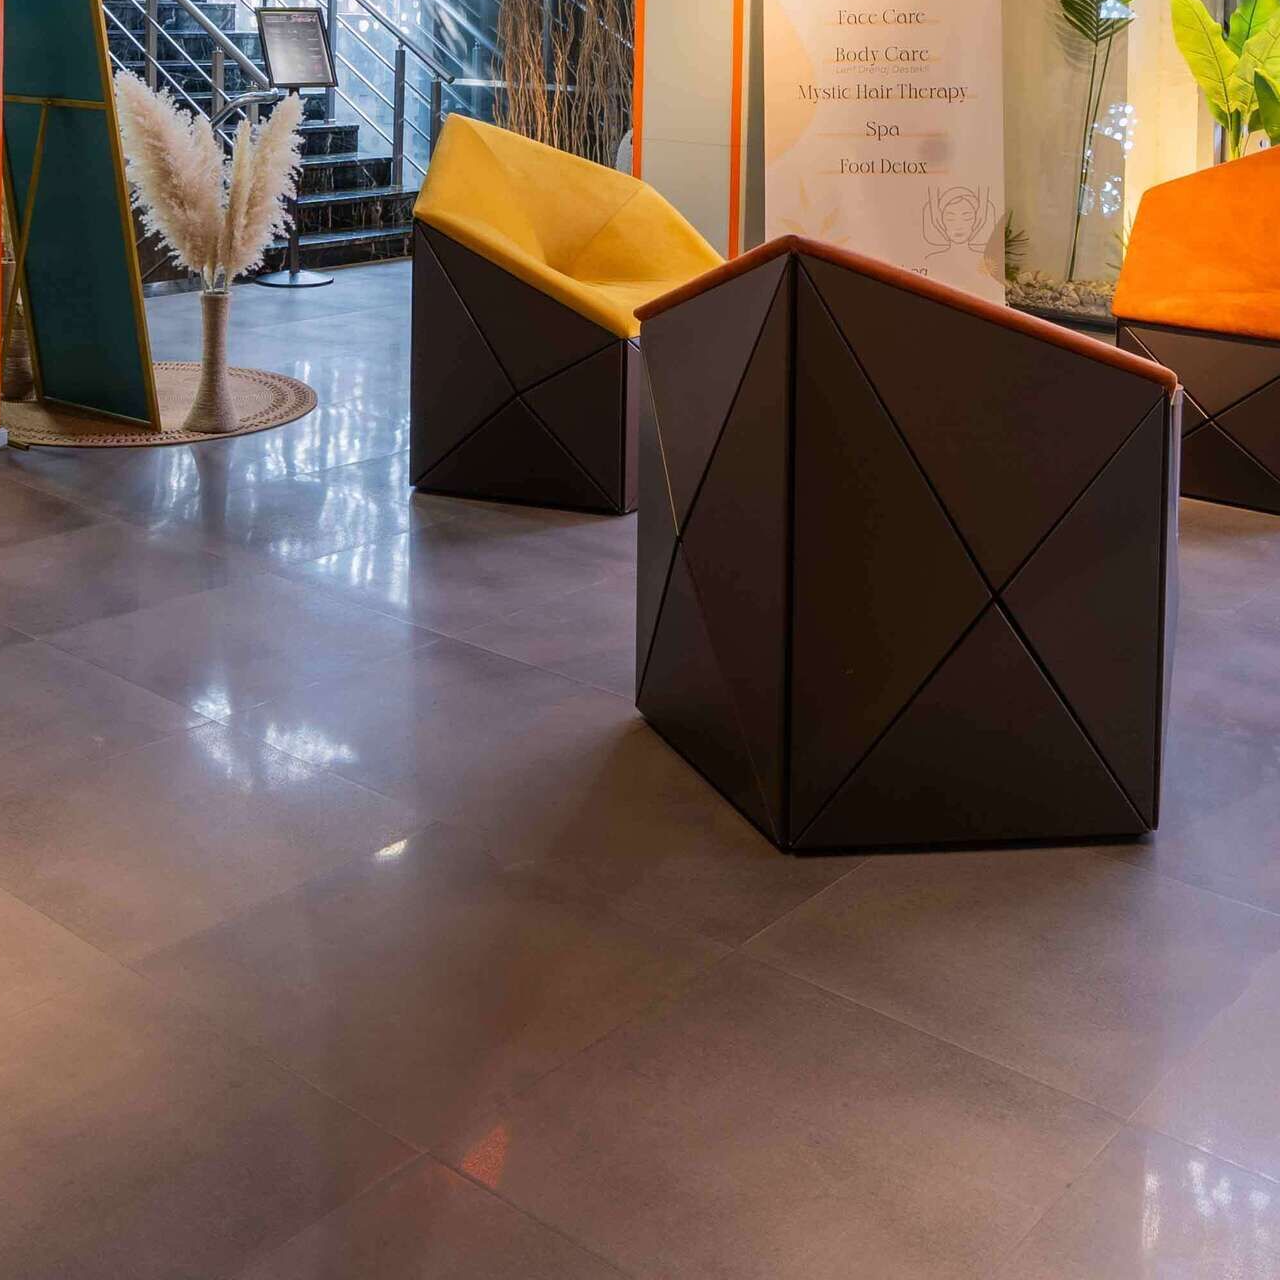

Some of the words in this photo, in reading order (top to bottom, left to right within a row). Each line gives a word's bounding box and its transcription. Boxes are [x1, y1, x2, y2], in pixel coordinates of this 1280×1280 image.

[838, 9, 878, 25] Face
[882, 9, 925, 24] Care
[835, 46, 879, 66] Body
[884, 46, 928, 61] Care
[797, 84, 850, 104] Mystic
[855, 83, 893, 100] Hair
[896, 82, 969, 104] Therapy
[865, 121, 900, 140] Spa
[840, 158, 876, 174] Foot
[880, 158, 928, 174] Detox
